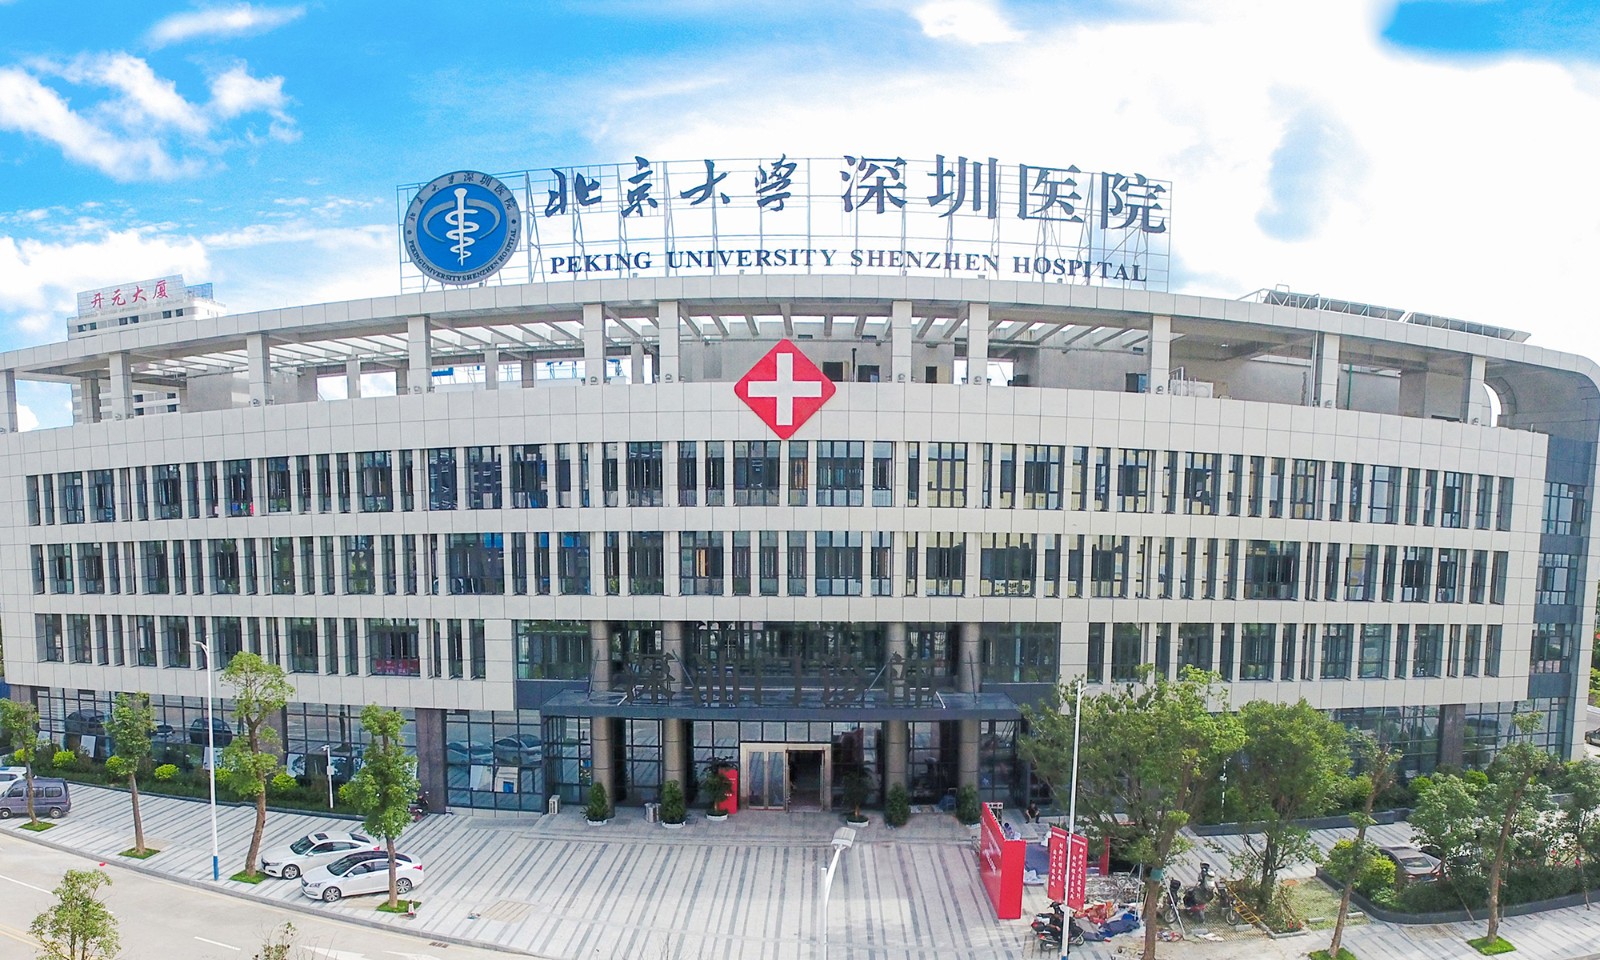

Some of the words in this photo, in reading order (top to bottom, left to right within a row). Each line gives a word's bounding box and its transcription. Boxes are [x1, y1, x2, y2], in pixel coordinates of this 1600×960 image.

[550, 251, 652, 275] PEKING
[667, 248, 838, 270] UNIVERSITY
[850, 248, 999, 272] SHENZHEN
[1013, 255, 1148, 283] HOSPITAL
[91, 279, 169, 309] 开元大厦
